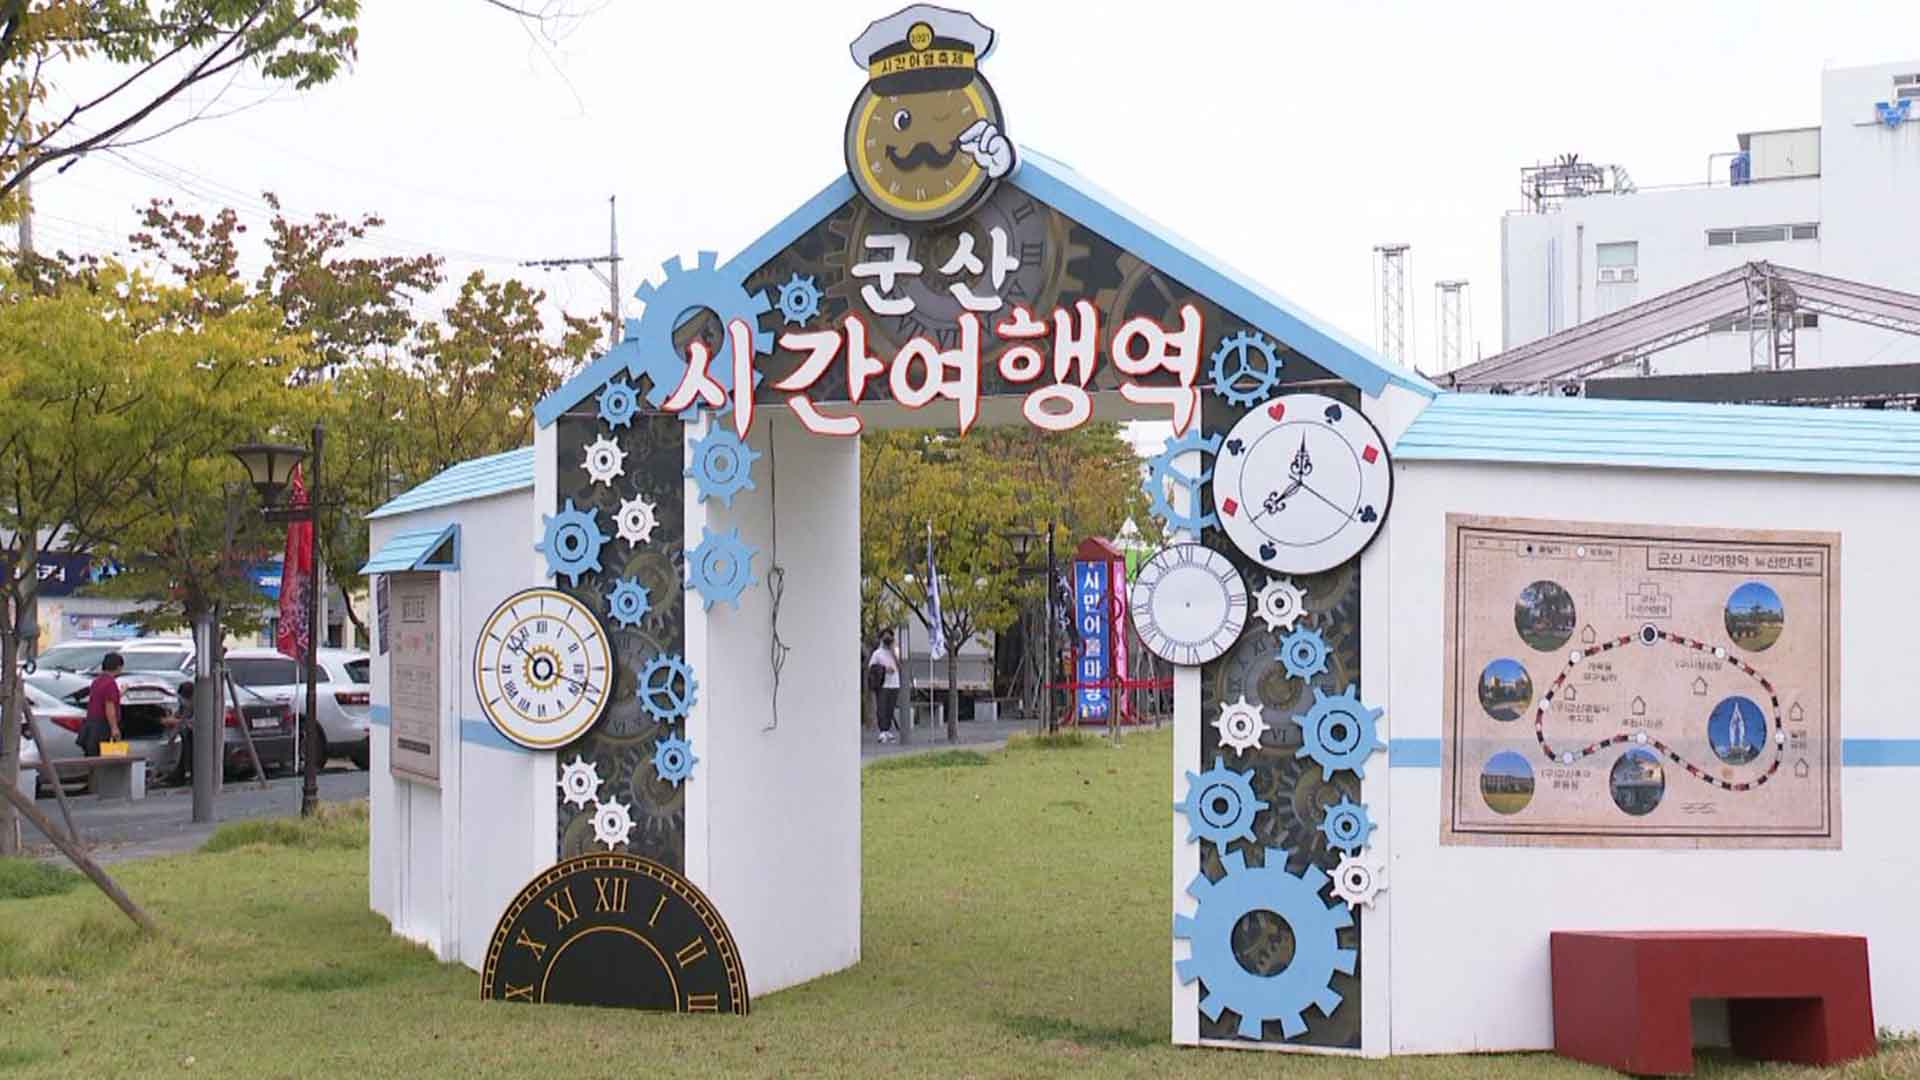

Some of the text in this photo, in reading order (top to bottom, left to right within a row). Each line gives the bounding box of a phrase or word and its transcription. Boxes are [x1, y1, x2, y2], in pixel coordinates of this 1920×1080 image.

[851, 226, 1020, 315] 군산
[662, 299, 1203, 440] 시간여행역
[544, 886, 579, 931] XI
[594, 877, 629, 913] XII
[648, 894, 668, 928] I
[516, 928, 548, 961] X
[675, 935, 709, 969] II
